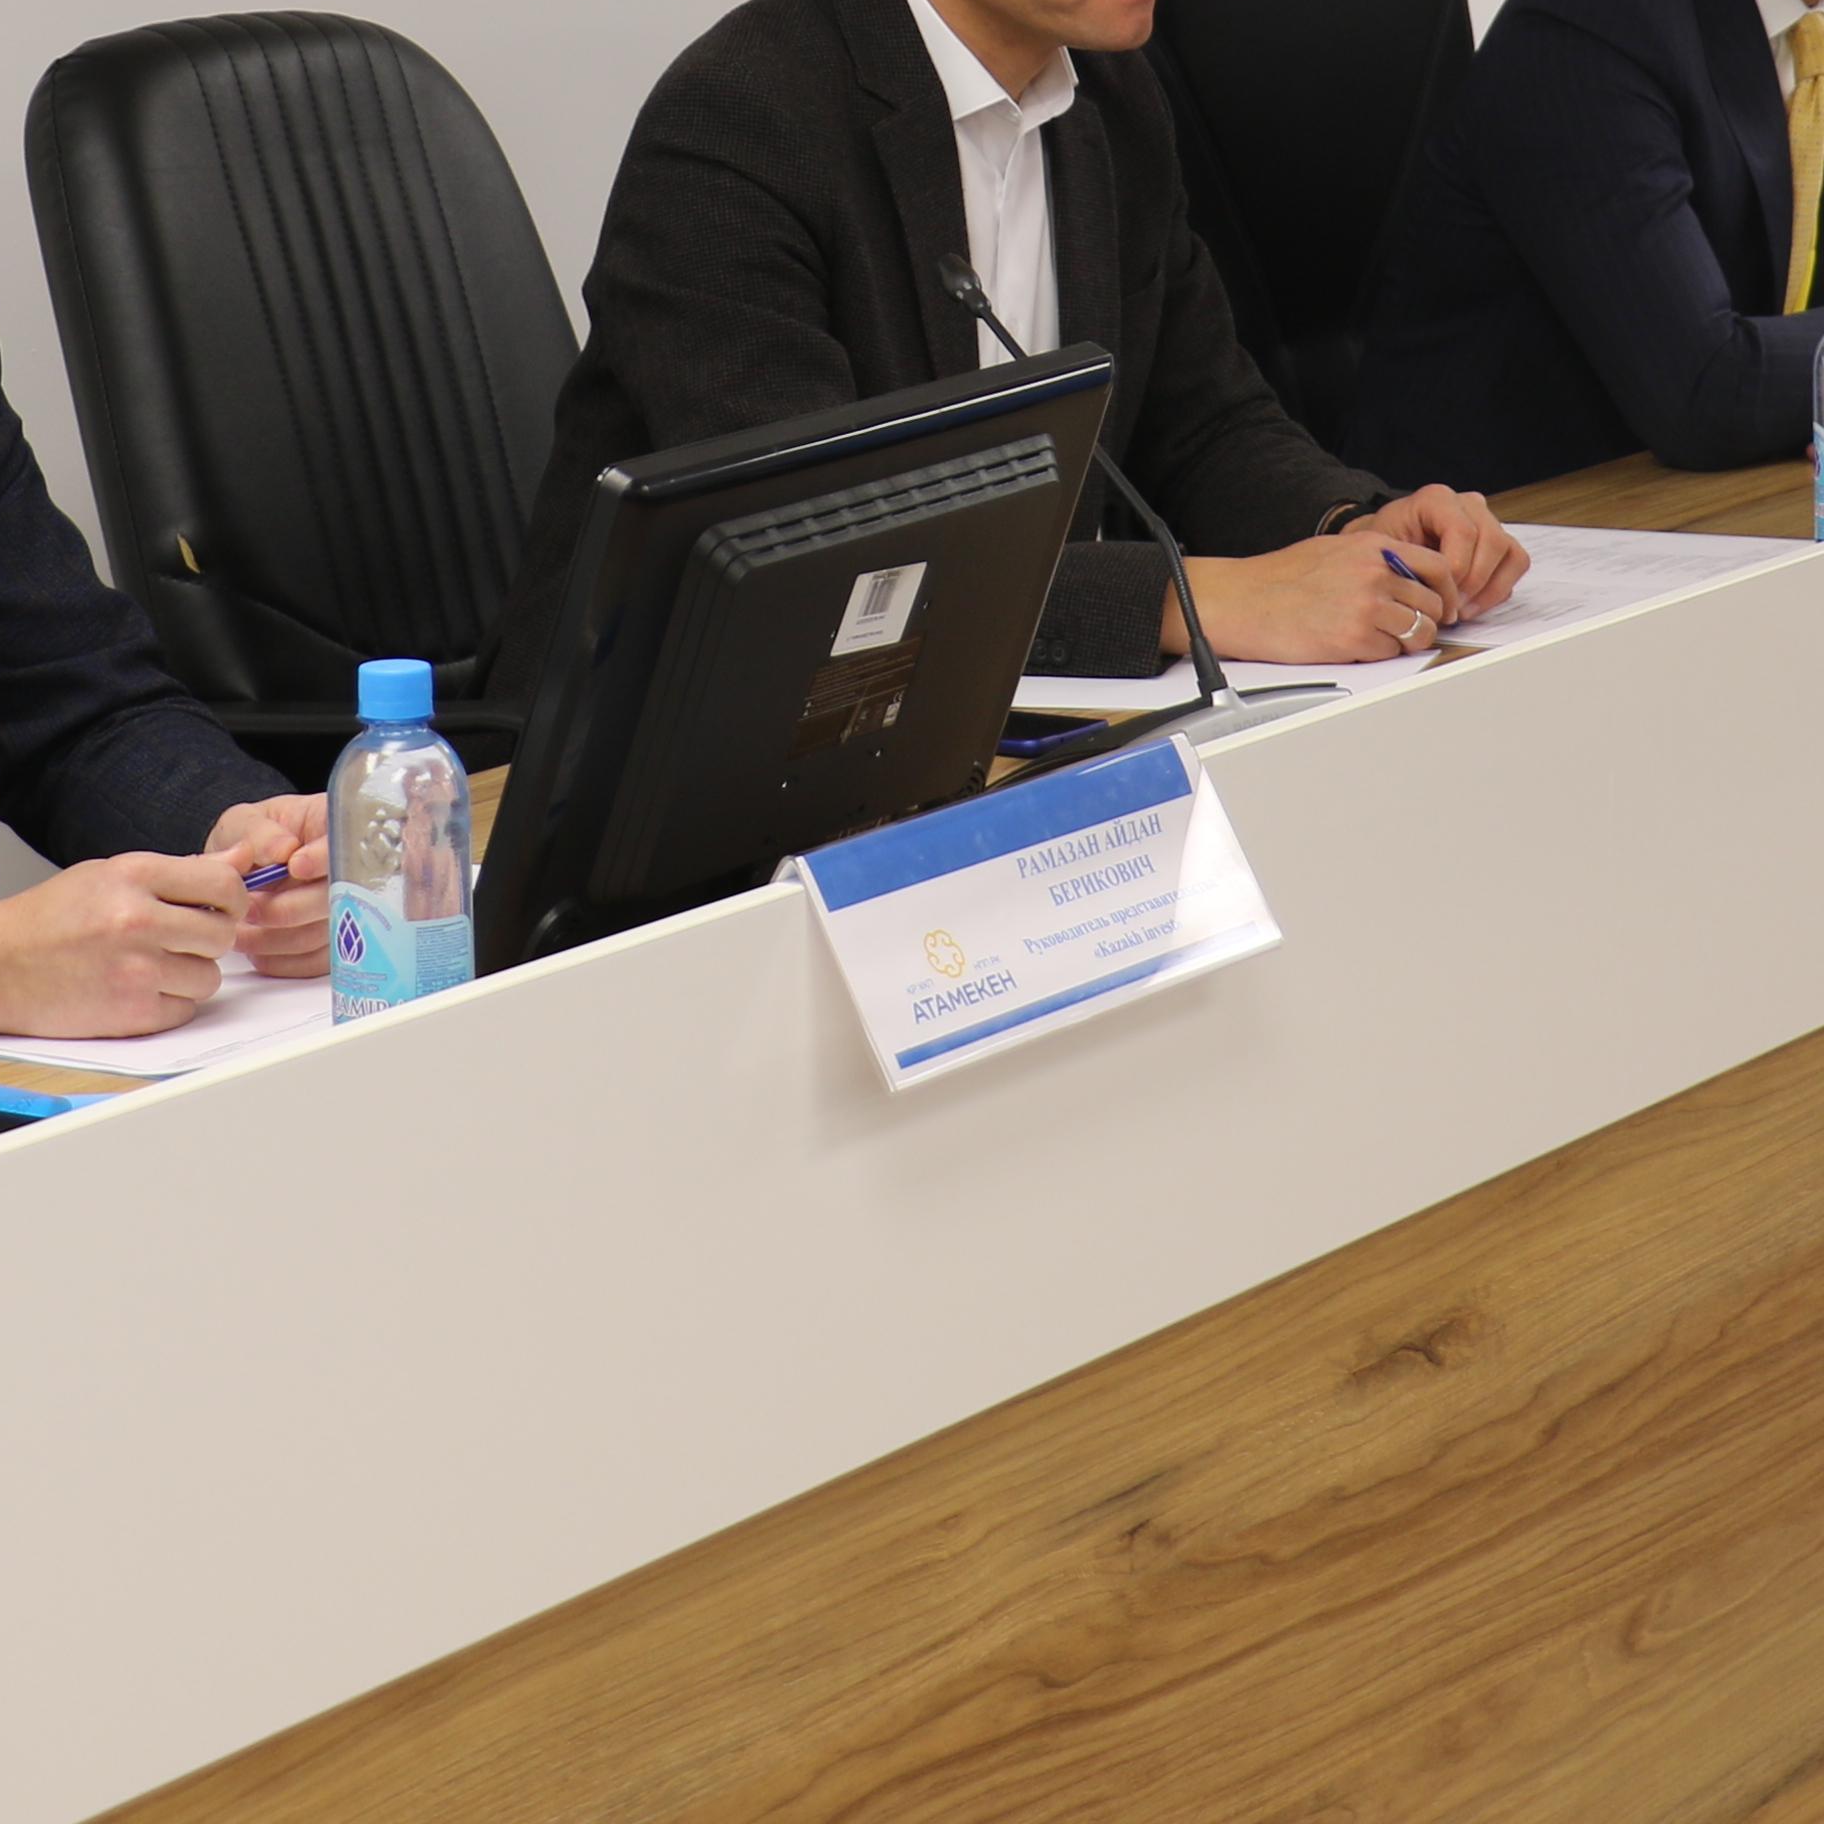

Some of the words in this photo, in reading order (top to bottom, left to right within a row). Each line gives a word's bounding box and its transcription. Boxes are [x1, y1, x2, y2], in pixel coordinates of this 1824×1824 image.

[1016, 835, 1100, 879] РАМАЗАН
[1104, 813, 1163, 852] АЙДАН
[1048, 854, 1156, 906] БЕРИКОВИЧ
[1023, 916, 1111, 956] Руководитель
[912, 969, 1018, 1024] АТАМЕКЕН
